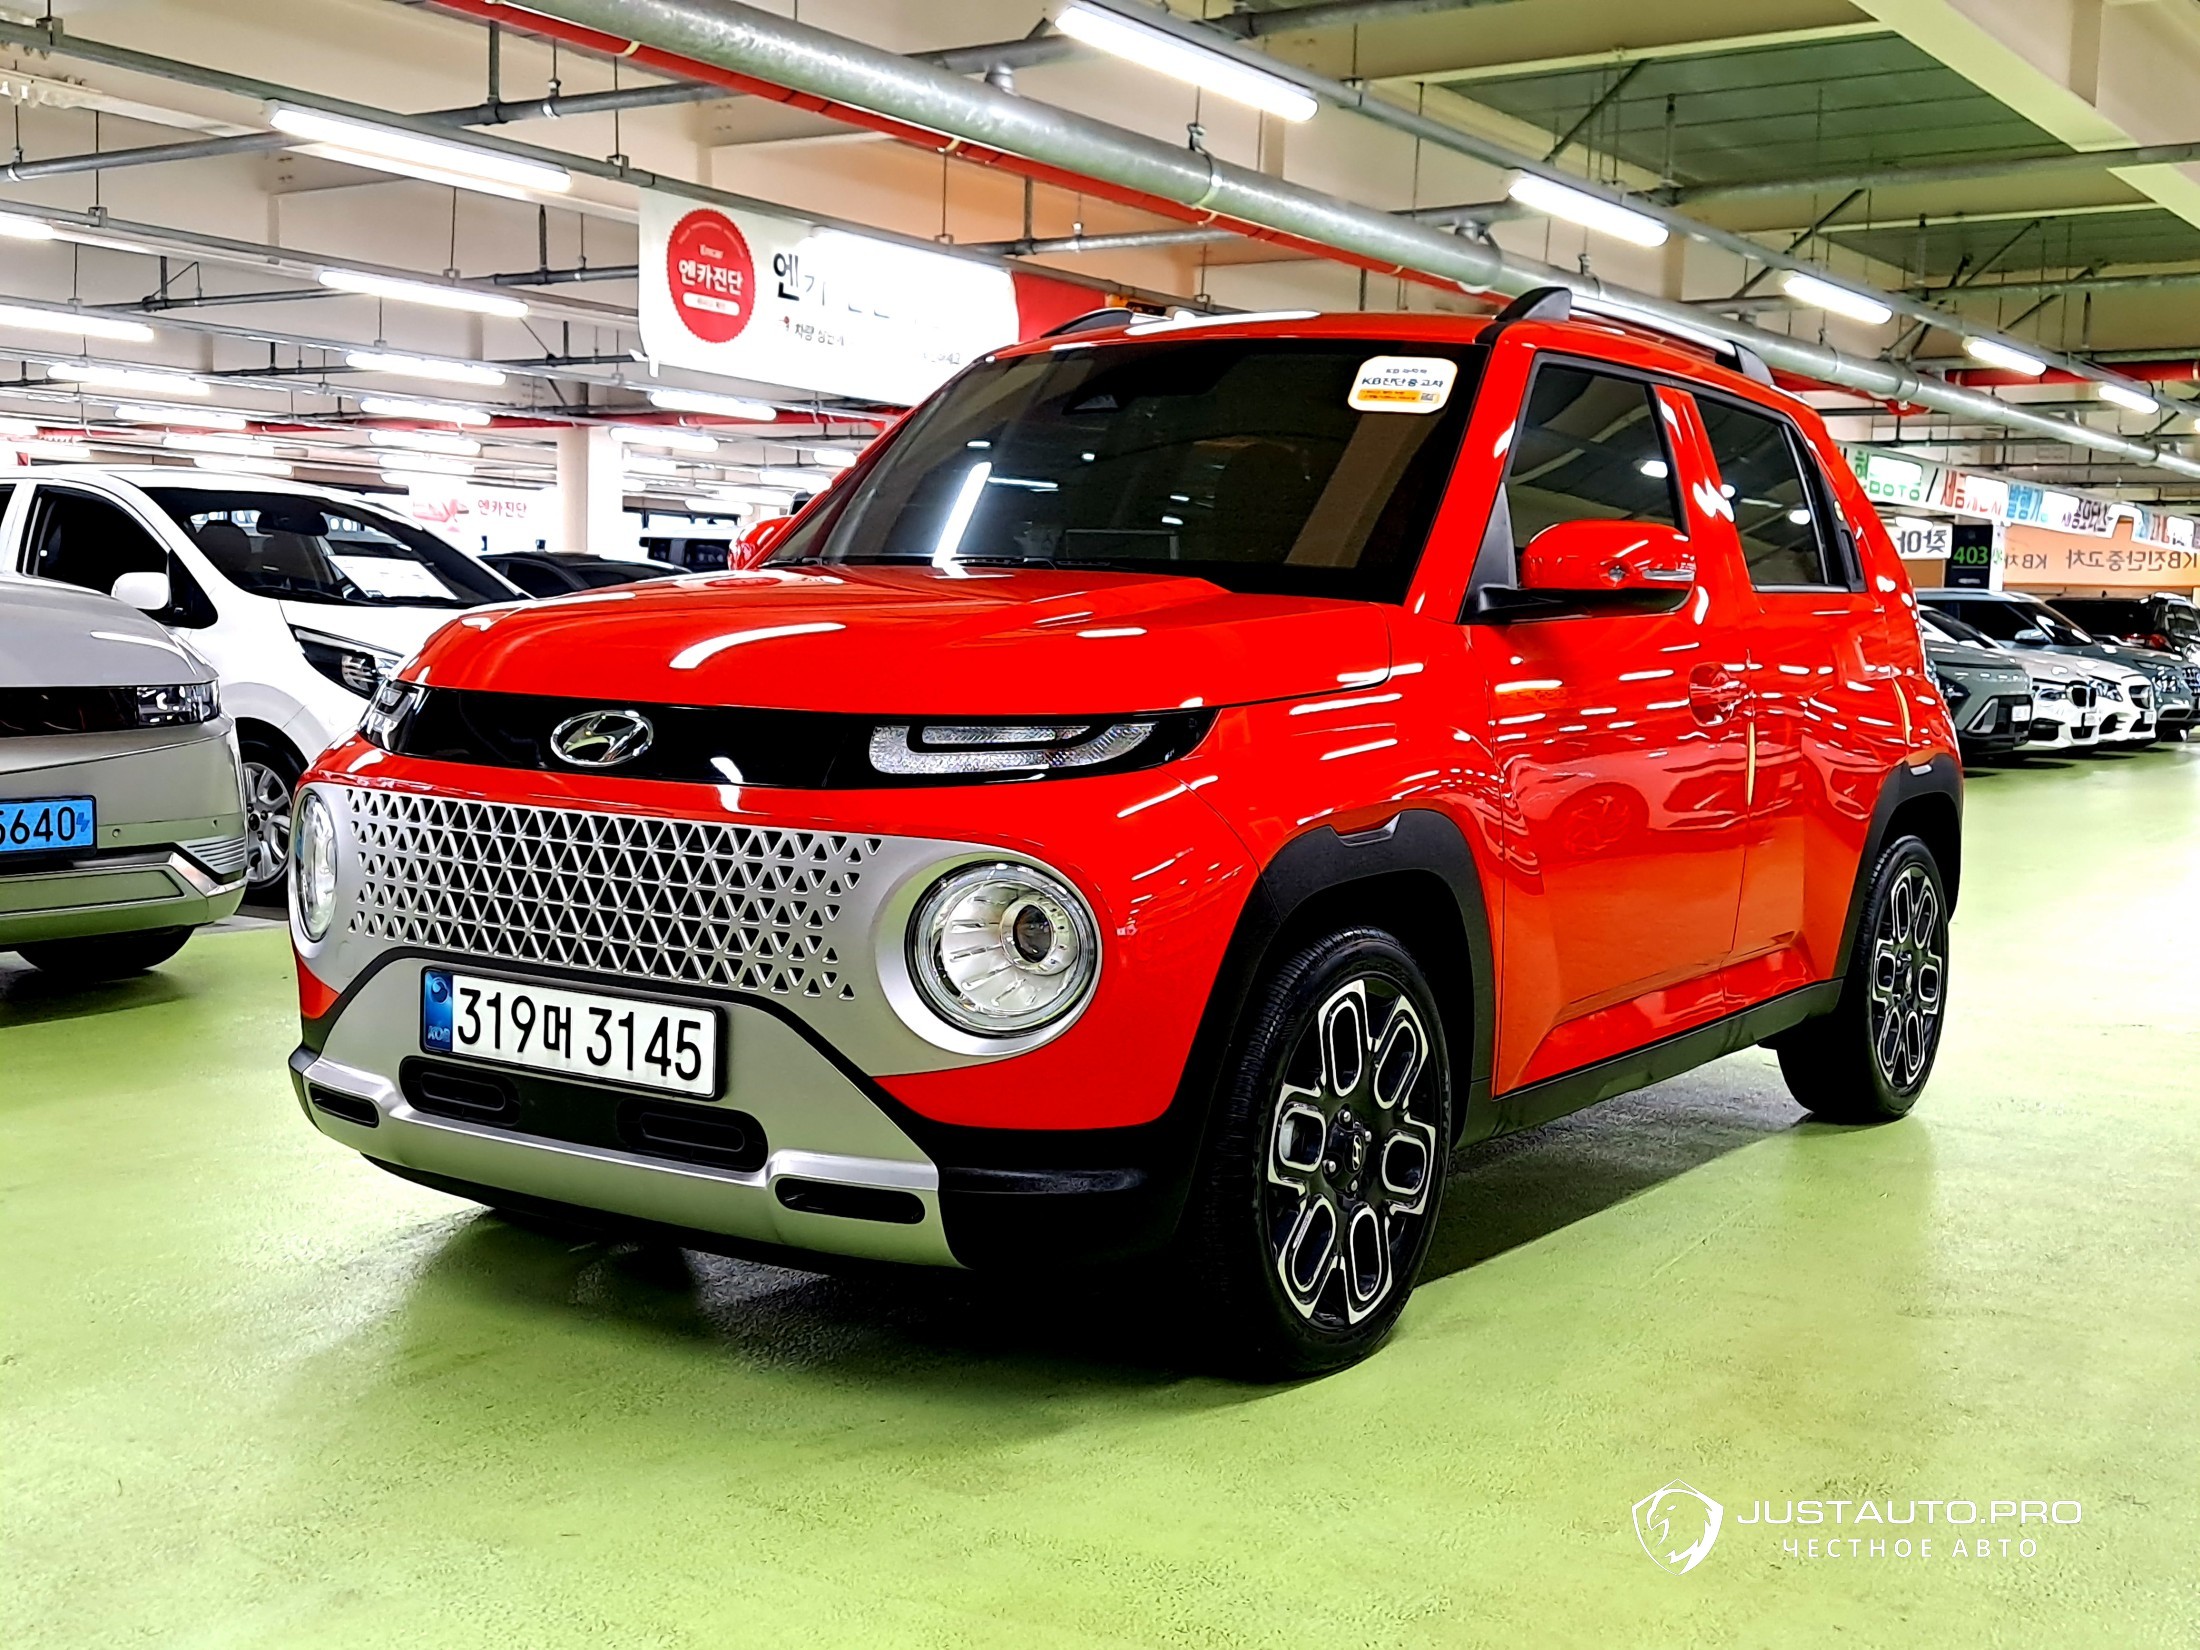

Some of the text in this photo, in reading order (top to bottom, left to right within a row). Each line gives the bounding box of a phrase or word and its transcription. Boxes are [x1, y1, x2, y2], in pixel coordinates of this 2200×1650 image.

[678, 259, 743, 296] 엔카진단
[477, 499, 528, 519] 엔카진단
[1953, 545, 1989, 565] 403
[0, 806, 76, 845] 640
[457, 987, 702, 1081] 319머 3145
